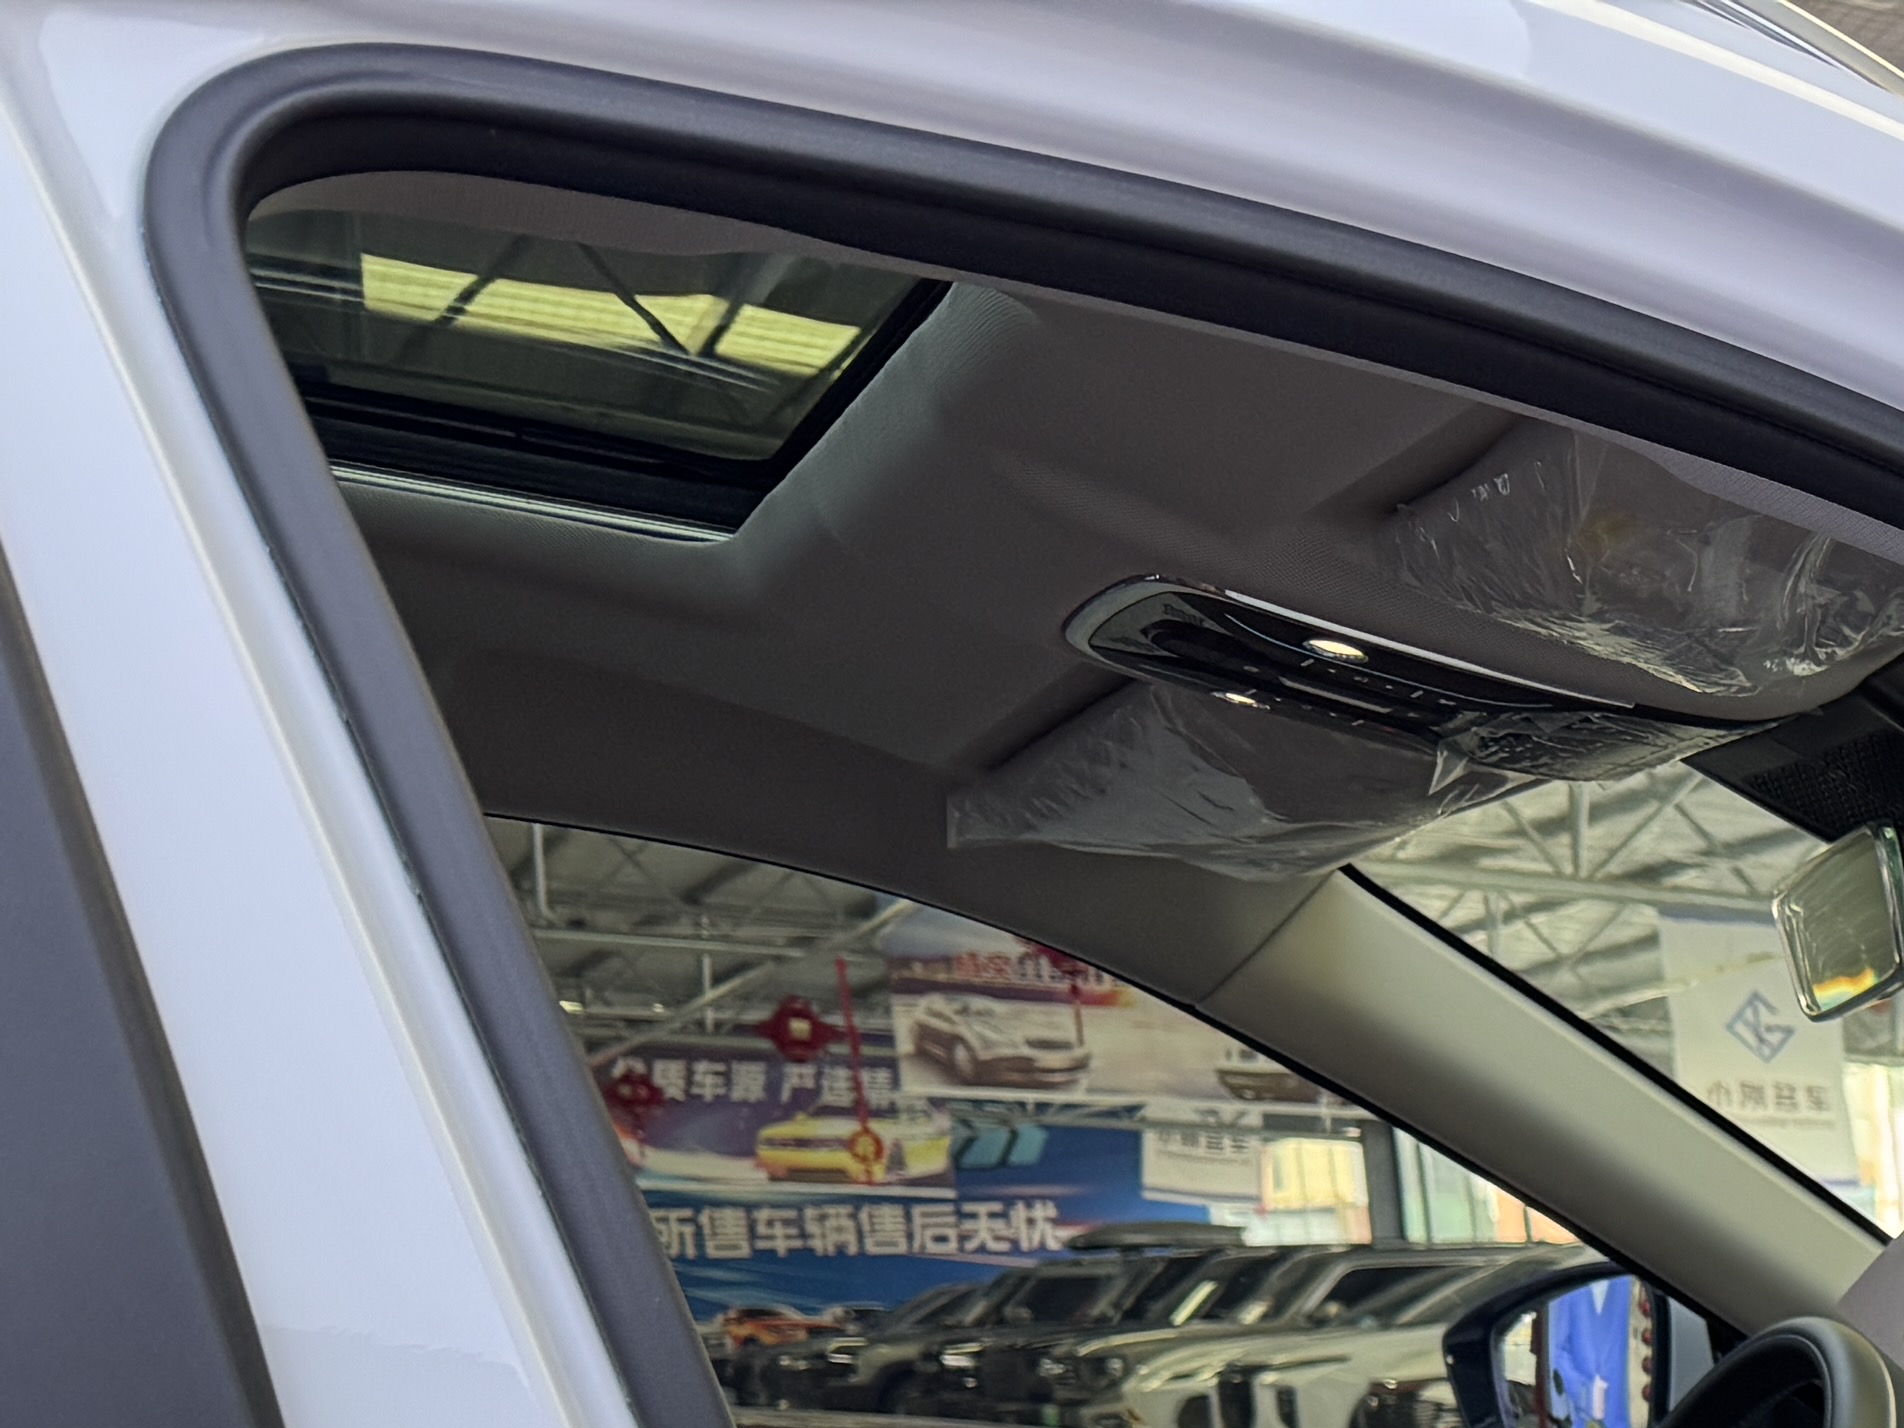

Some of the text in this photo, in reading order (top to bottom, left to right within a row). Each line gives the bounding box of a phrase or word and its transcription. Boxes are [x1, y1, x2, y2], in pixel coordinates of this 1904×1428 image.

[650, 1199, 1064, 1260] 所售车辆售后无忧
